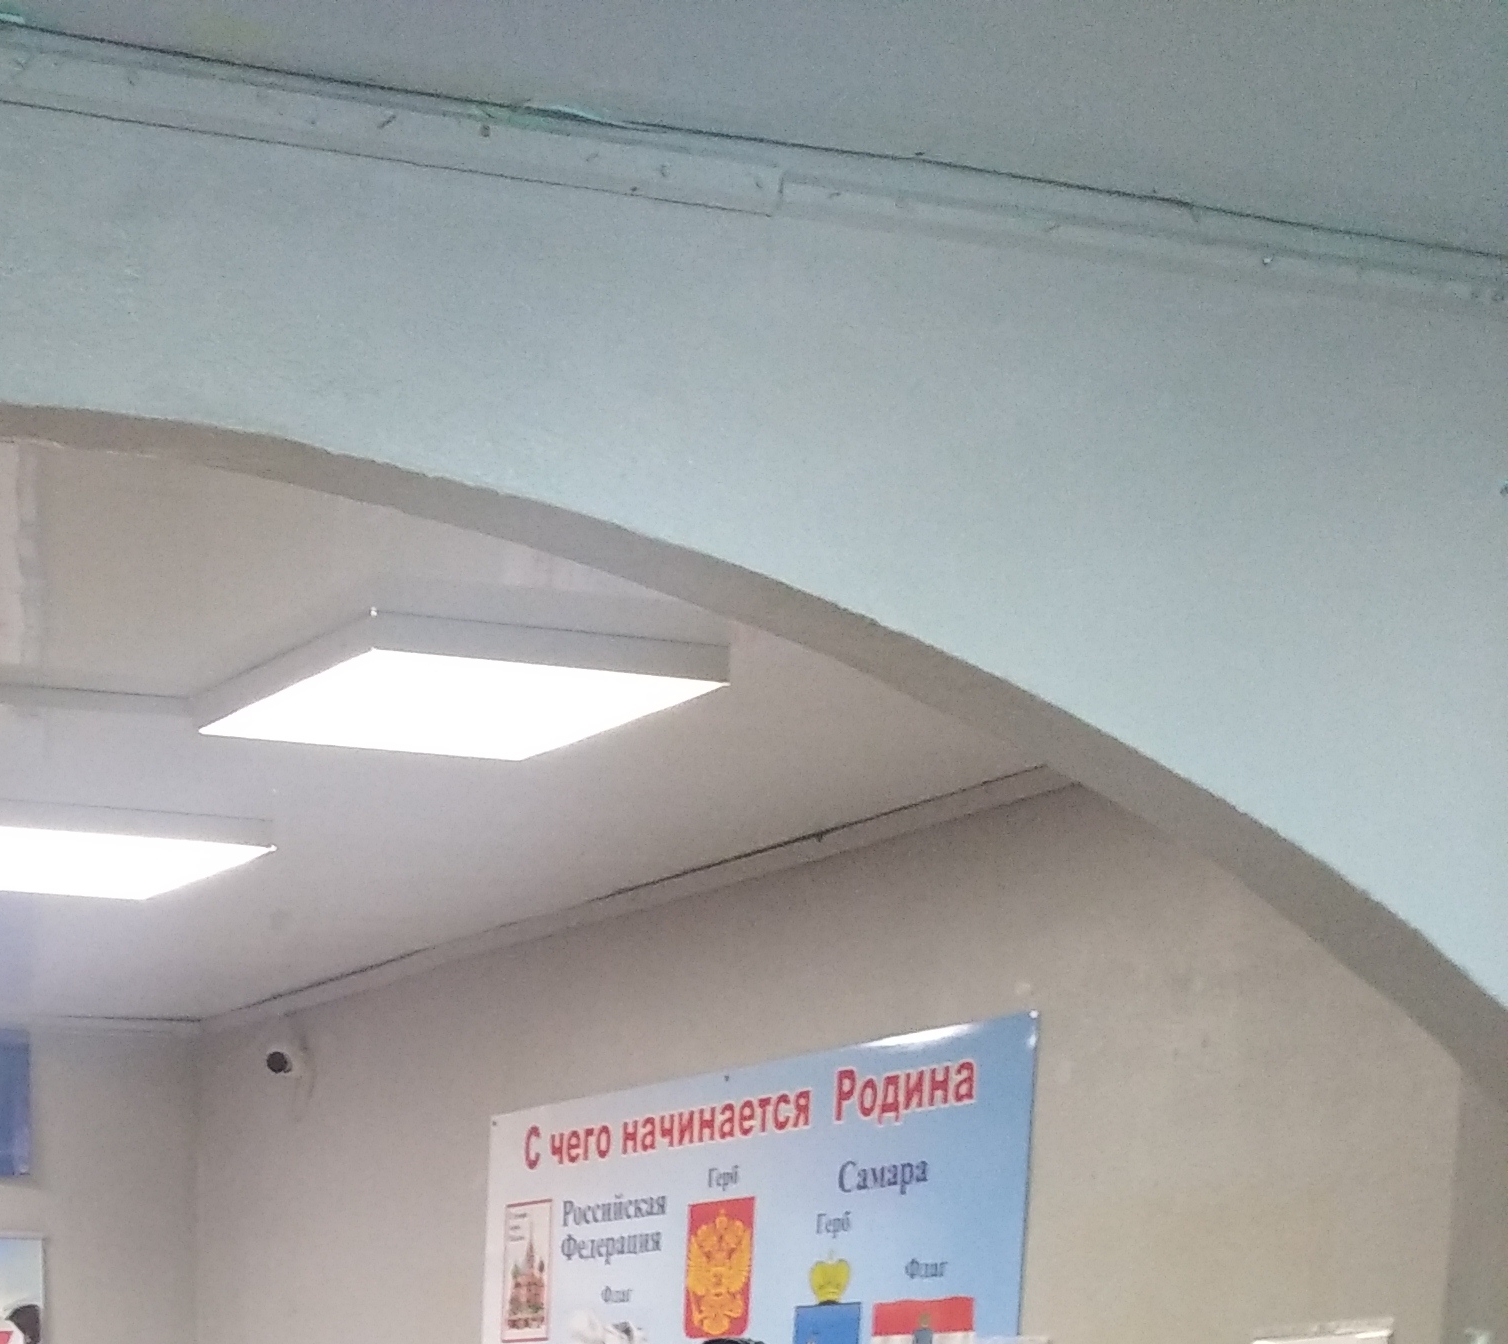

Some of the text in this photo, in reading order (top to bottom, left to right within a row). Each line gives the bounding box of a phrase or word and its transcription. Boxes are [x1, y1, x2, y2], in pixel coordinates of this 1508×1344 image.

[524, 1060, 977, 1170] С чего начинается Родина
[837, 1160, 929, 1195] Самара
[562, 1193, 667, 1227] Российская
[561, 1233, 663, 1265] Федерация
